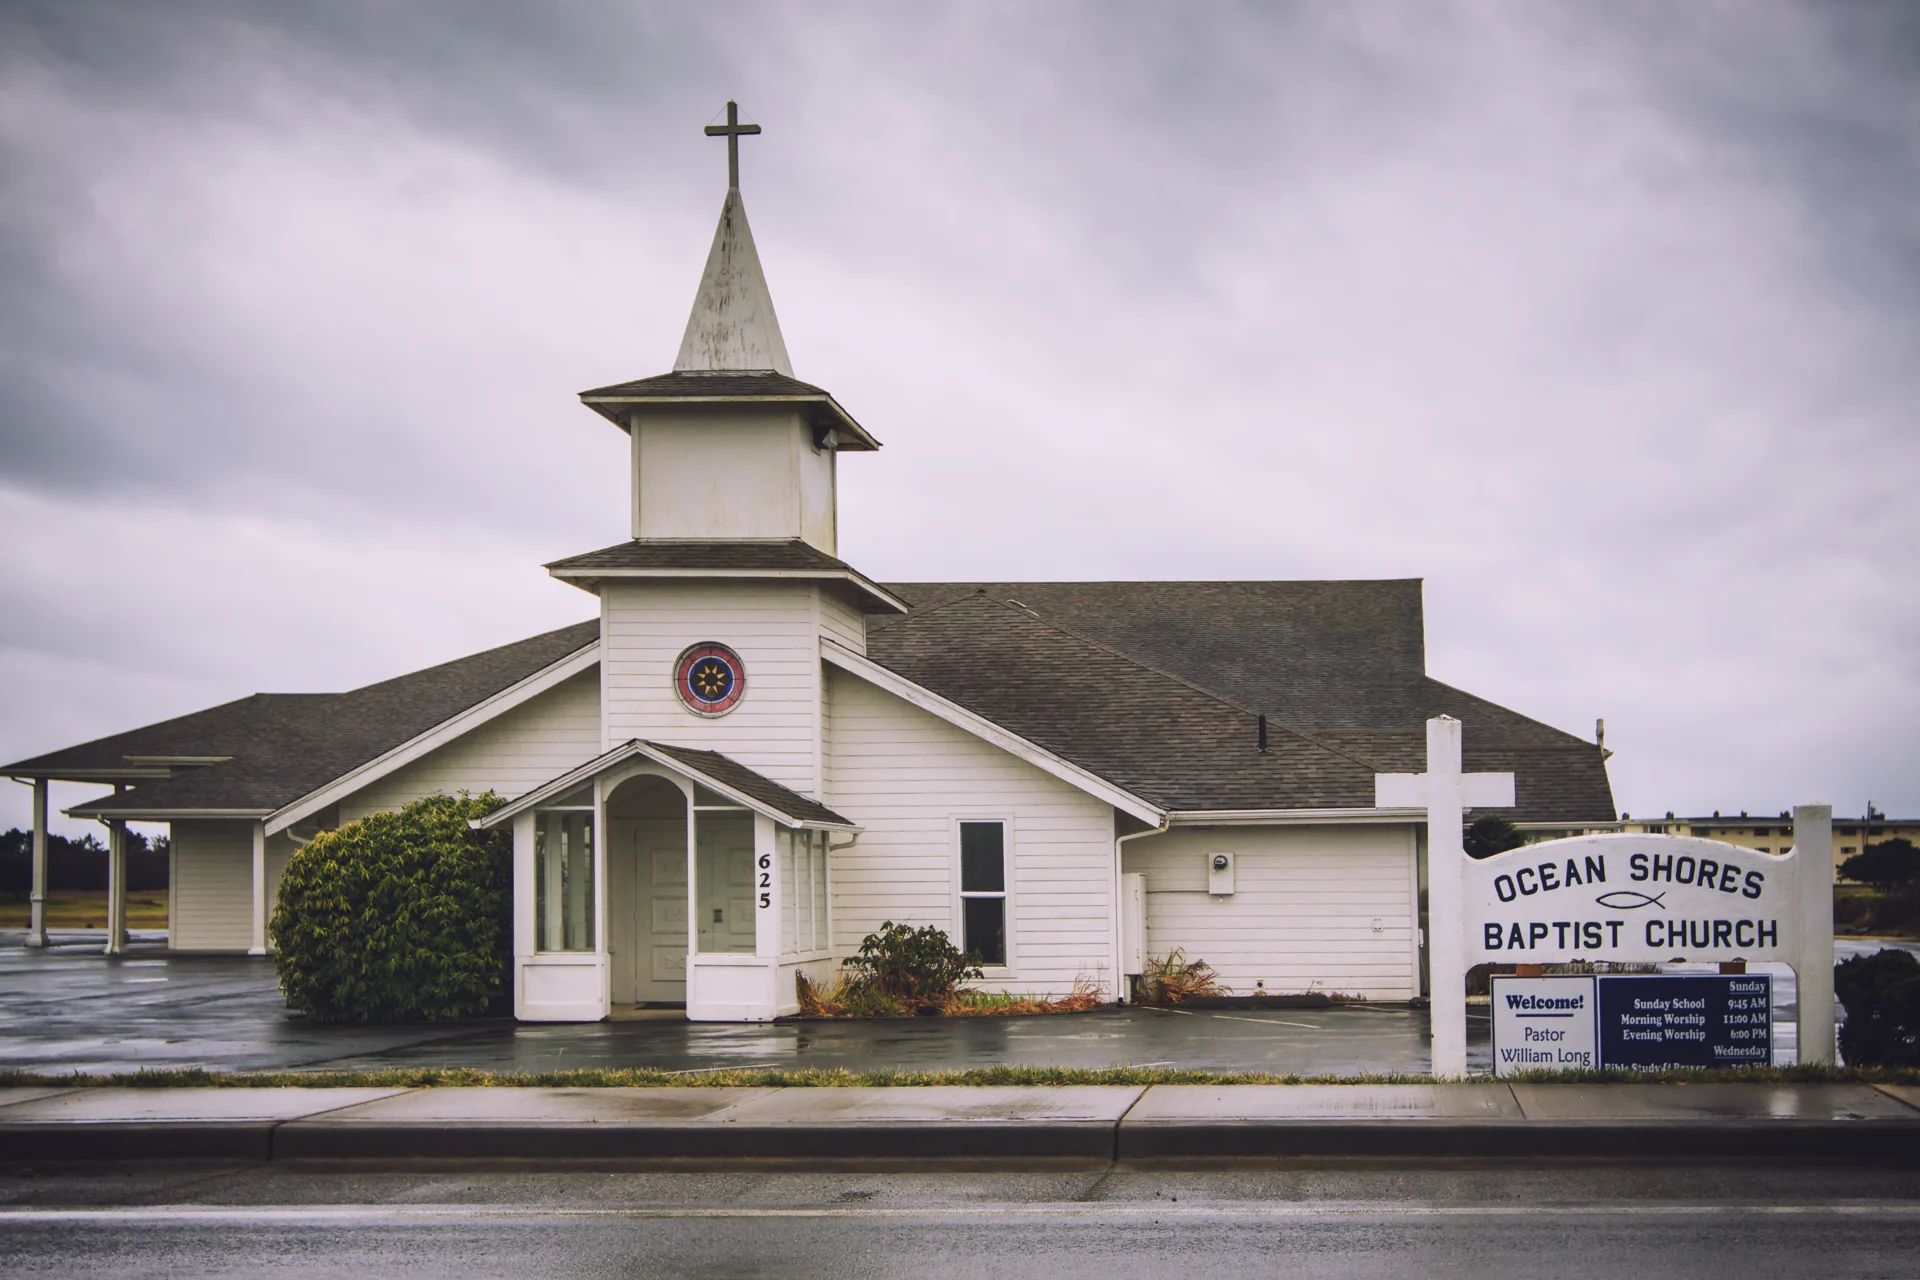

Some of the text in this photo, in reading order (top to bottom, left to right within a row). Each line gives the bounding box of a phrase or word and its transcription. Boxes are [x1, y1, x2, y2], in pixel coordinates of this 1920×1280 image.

[759, 853, 771, 909] 625
[1494, 853, 1765, 902] OCEAN SHORES
[1484, 919, 1778, 950] BAPTIST CHURCH
[1729, 980, 1766, 993] Sunday
[1505, 994, 1584, 1009] Welcome!
[1634, 998, 1766, 1011] Sunday School 9:45 AM
[1621, 1013, 1766, 1027] Morning Worship 11:00 AM
[1524, 1026, 1566, 1041] Pastor
[1623, 1028, 1767, 1042] Evening Worship 6:00 PM
[1500, 1048, 1591, 1066] William Long
[1713, 1045, 1767, 1057] Wednesday
